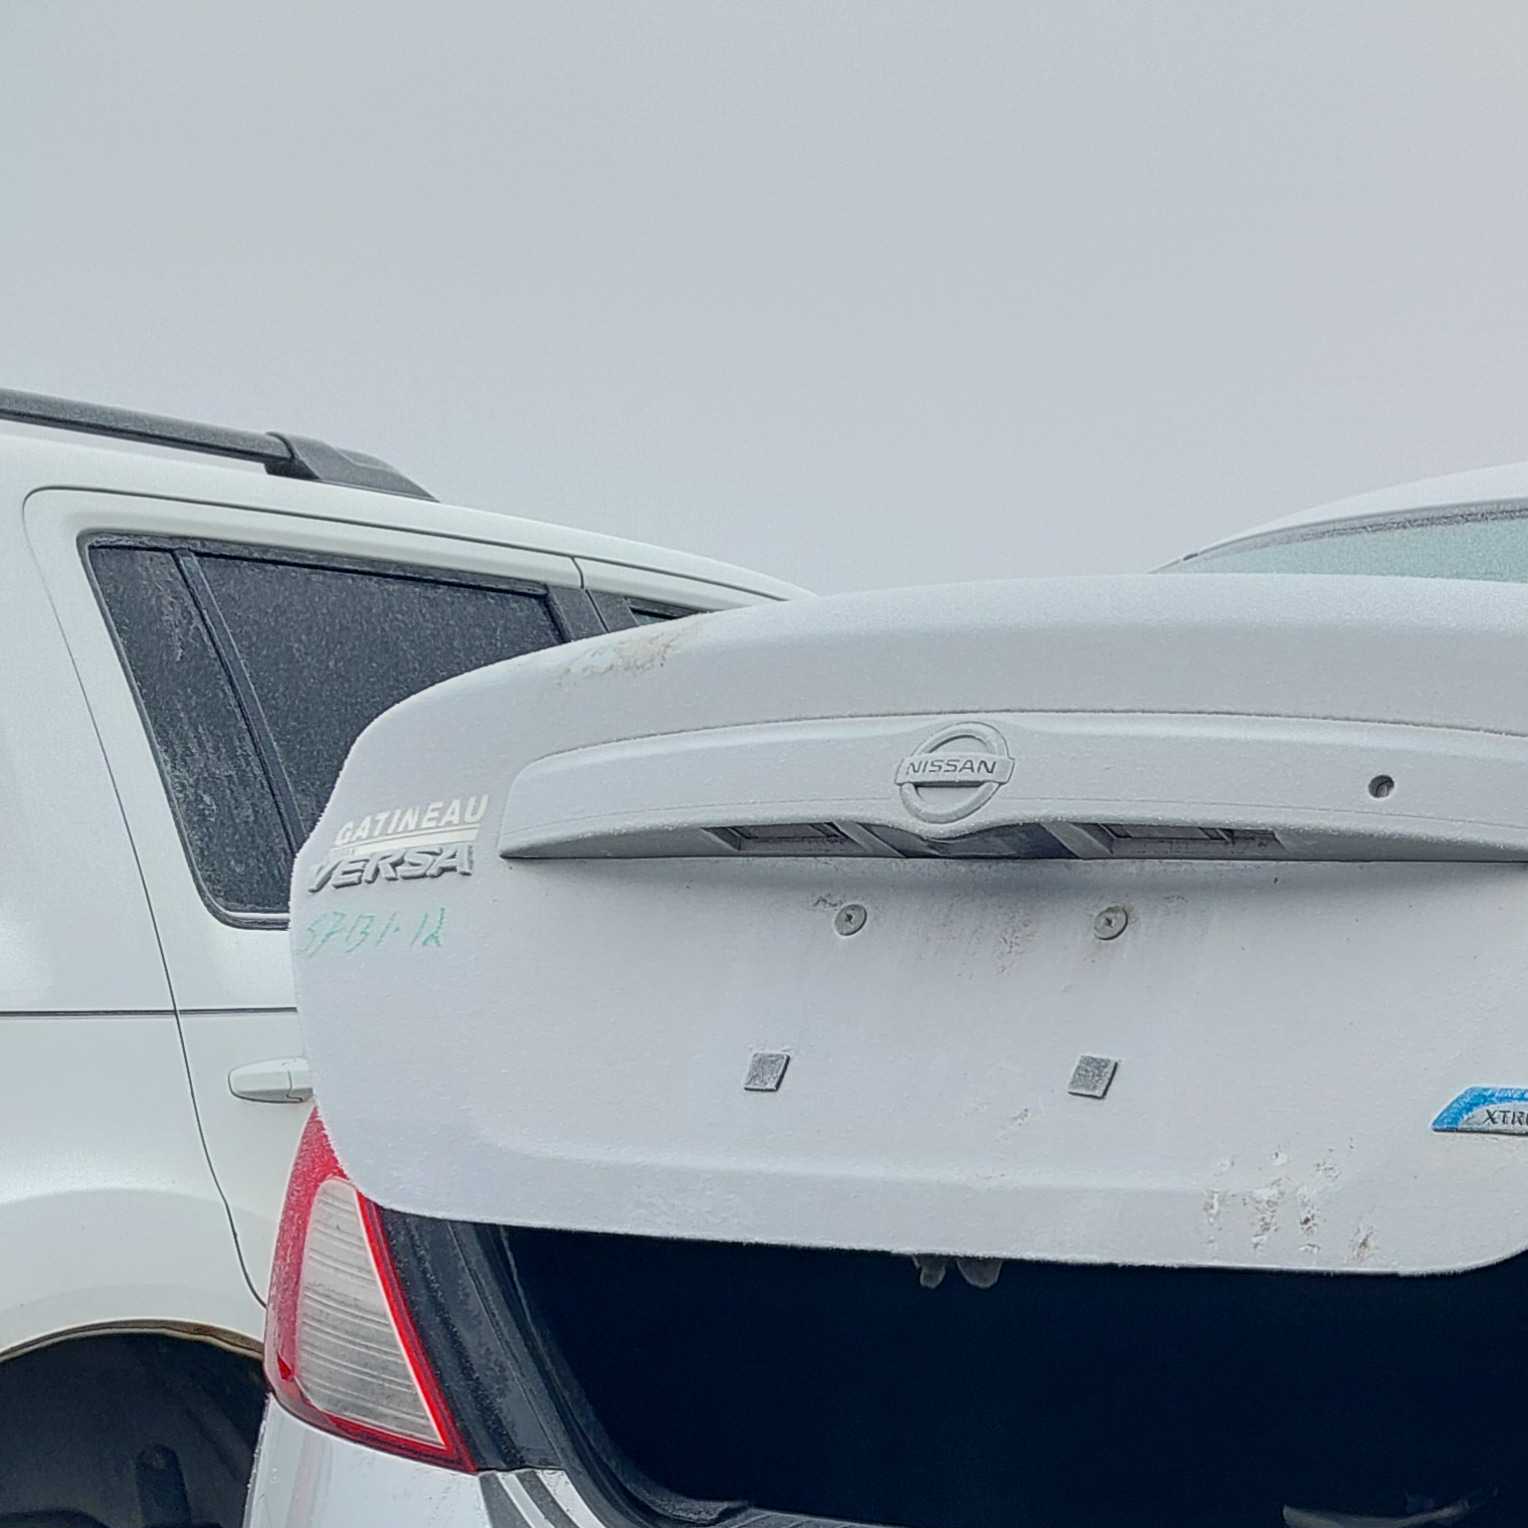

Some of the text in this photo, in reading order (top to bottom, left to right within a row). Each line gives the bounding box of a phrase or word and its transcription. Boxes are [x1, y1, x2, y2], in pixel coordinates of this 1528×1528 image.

[905, 758, 997, 776] NISSAN
[334, 794, 490, 847] GATINEAU
[307, 845, 474, 893] VERSA
